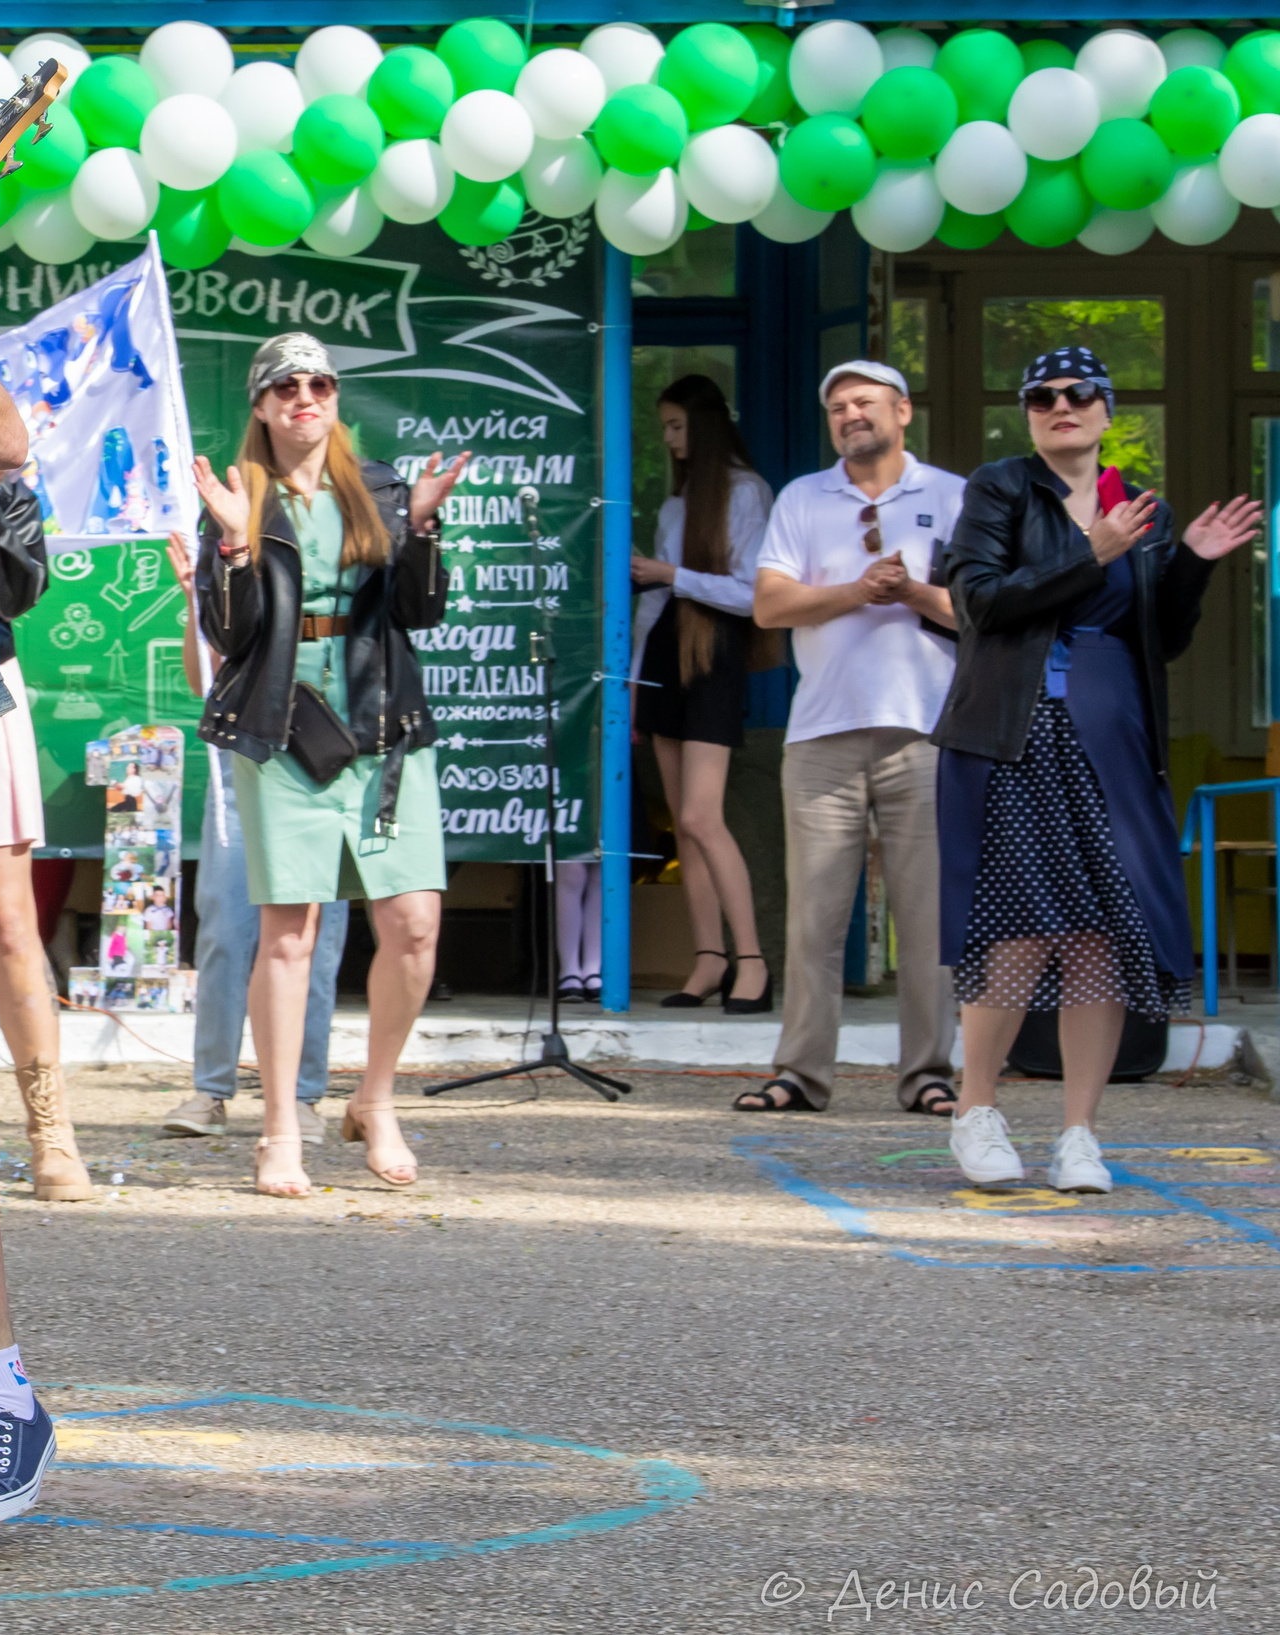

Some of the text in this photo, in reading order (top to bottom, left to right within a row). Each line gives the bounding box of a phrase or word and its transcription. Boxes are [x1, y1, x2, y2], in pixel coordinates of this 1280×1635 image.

[170, 268, 391, 340] ЗВОНОК
[396, 409, 549, 445] РАДУЙСЯ
[448, 565, 465, 591] А
[422, 665, 546, 699] ПРЕДЕЛЫ
[427, 700, 561, 722] ожностей
[440, 797, 583, 845] ествуй!
